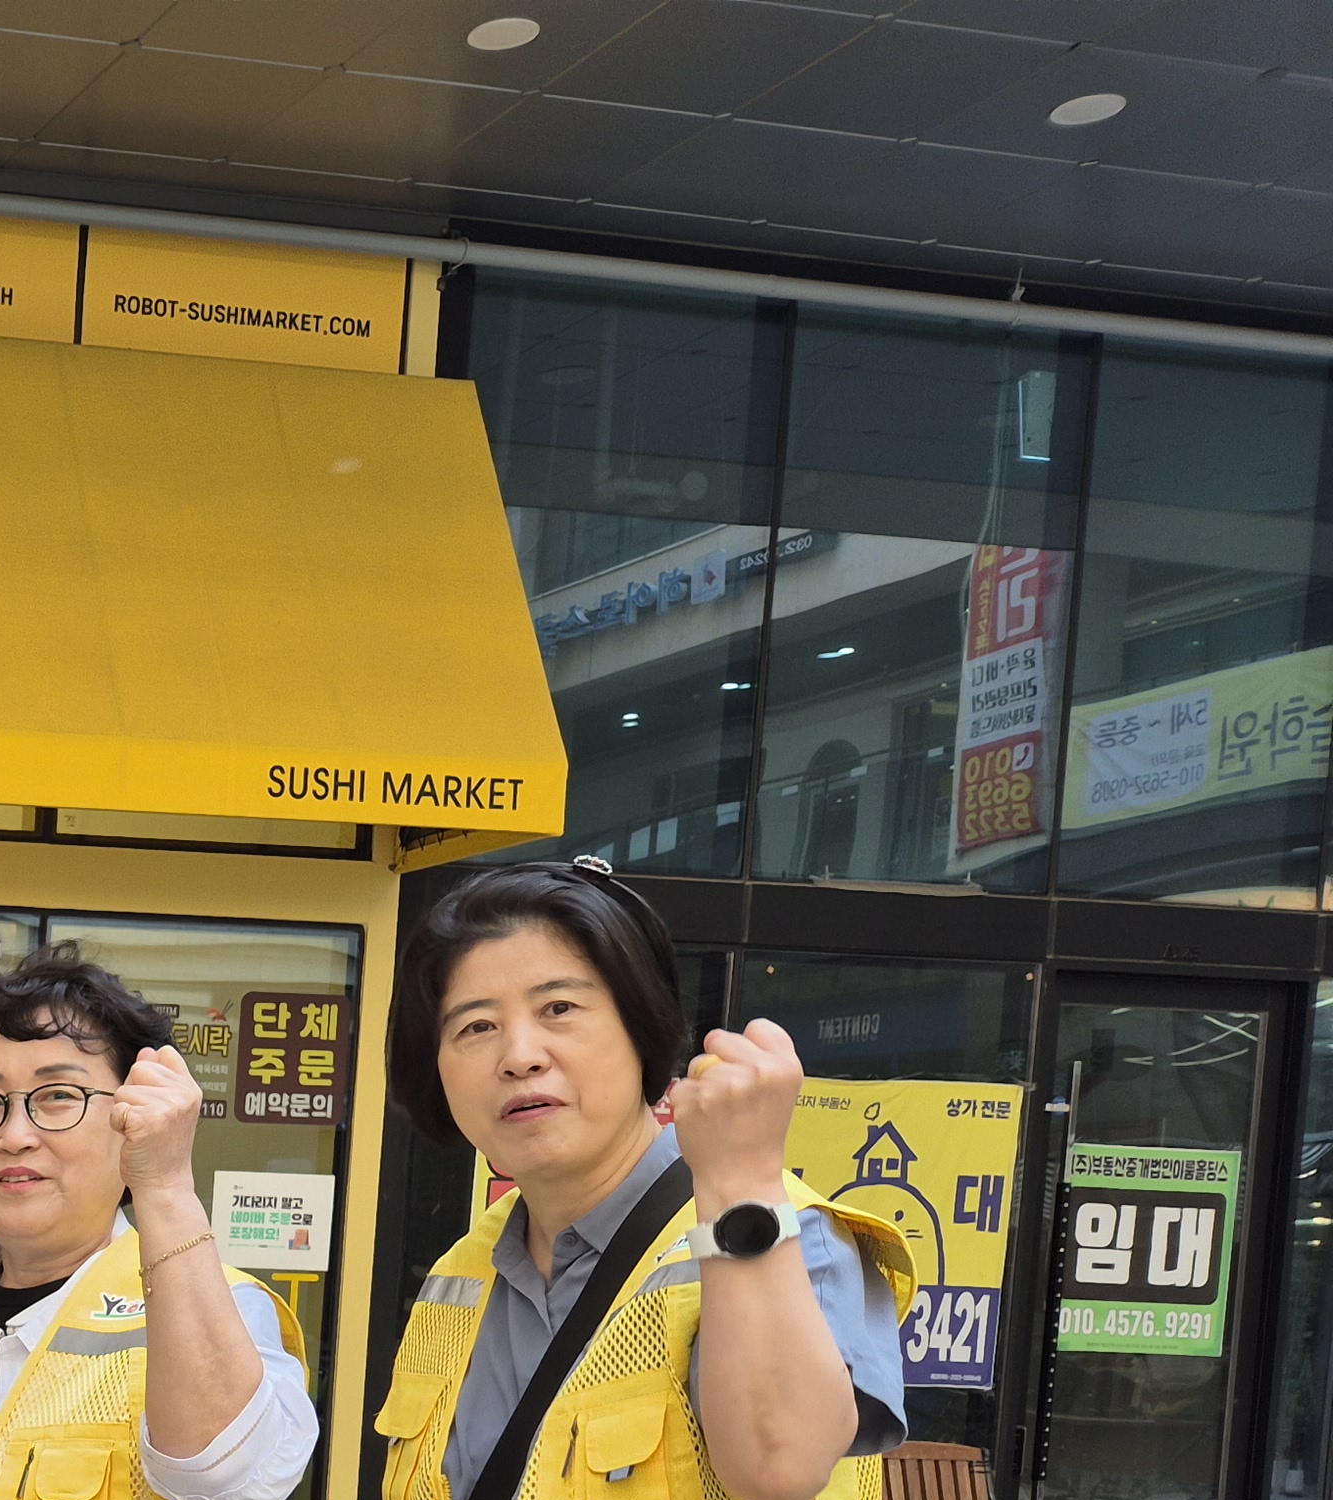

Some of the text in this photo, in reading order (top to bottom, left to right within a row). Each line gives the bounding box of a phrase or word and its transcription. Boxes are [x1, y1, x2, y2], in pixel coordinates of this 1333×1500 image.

[112, 293, 372, 339] ROBOT-SUSHIMARKET.COM
[266, 764, 525, 812] SUSHI MARKET
[244, 1091, 333, 1119] 예약문의
[818, 1096, 851, 1111] 부동산
[946, 1099, 1011, 1119] 상가 전문
[232, 1194, 303, 1209] 기다리지 말고
[230, 1210, 313, 1226] 네이버 주문으로
[229, 1226, 281, 1241] 포장해요!
[906, 1289, 991, 1364] 3421
